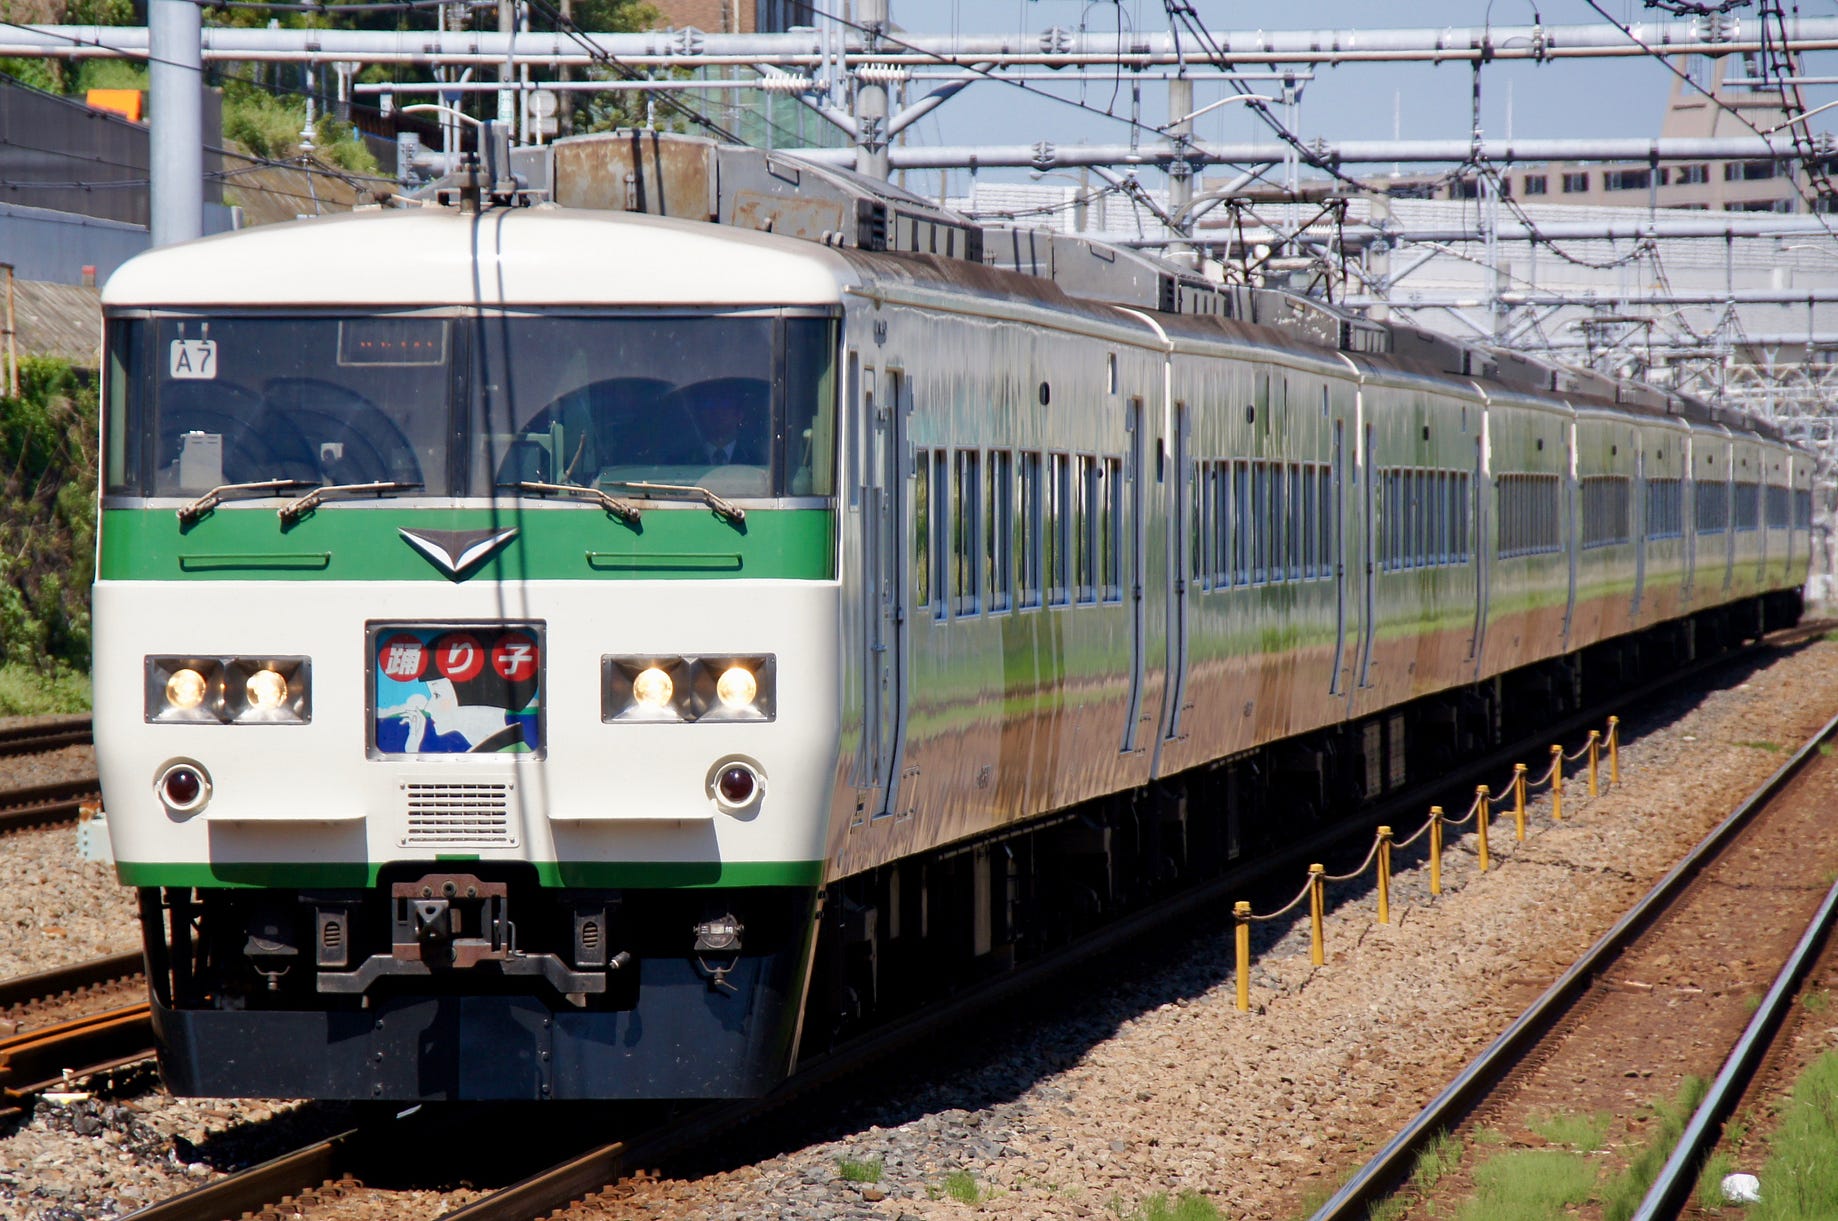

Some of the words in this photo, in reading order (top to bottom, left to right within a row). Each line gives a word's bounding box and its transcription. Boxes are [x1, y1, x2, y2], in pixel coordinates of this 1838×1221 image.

[175, 347, 211, 373] A7
[385, 642, 533, 675] 踊り子
